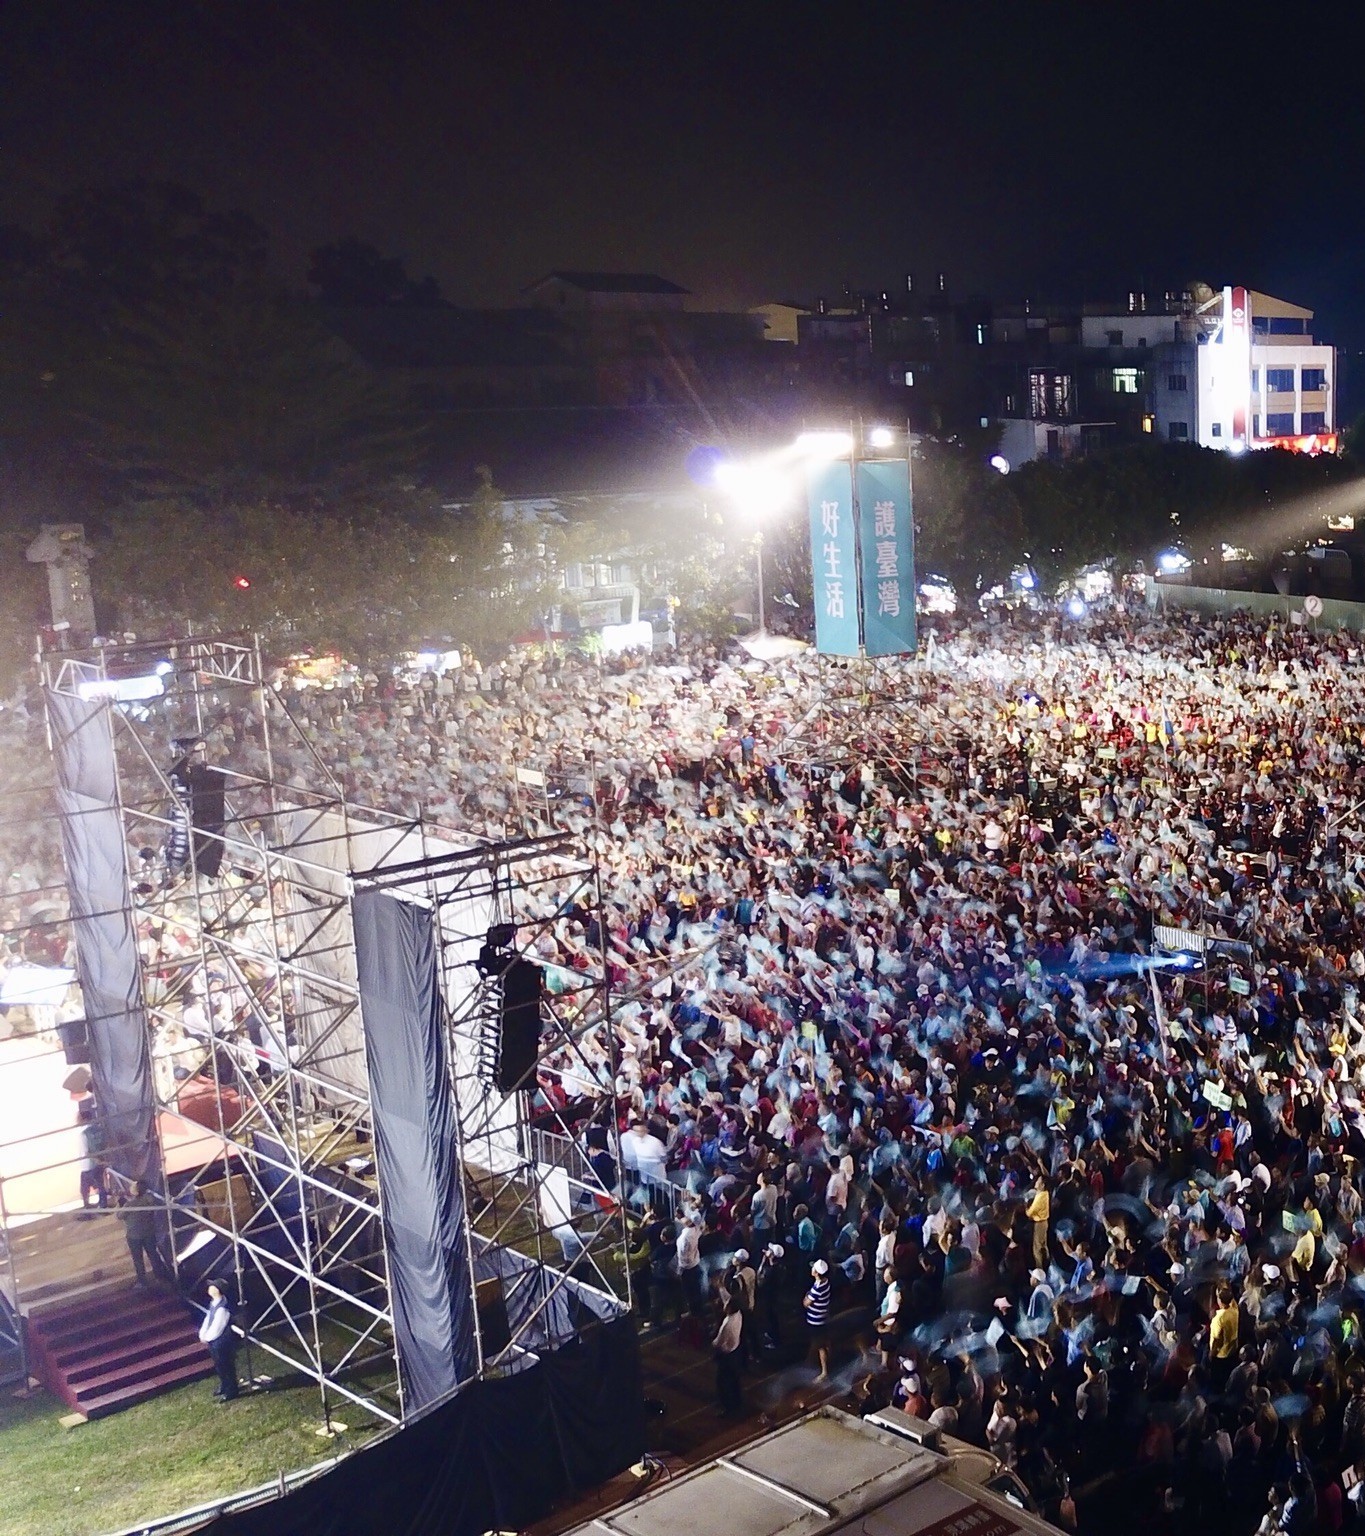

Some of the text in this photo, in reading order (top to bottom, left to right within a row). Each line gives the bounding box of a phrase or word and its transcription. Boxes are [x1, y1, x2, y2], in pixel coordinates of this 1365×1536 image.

[820, 500, 844, 619] 好生活
[874, 500, 900, 617] 護臺灣
[1309, 597, 1319, 612] 2
